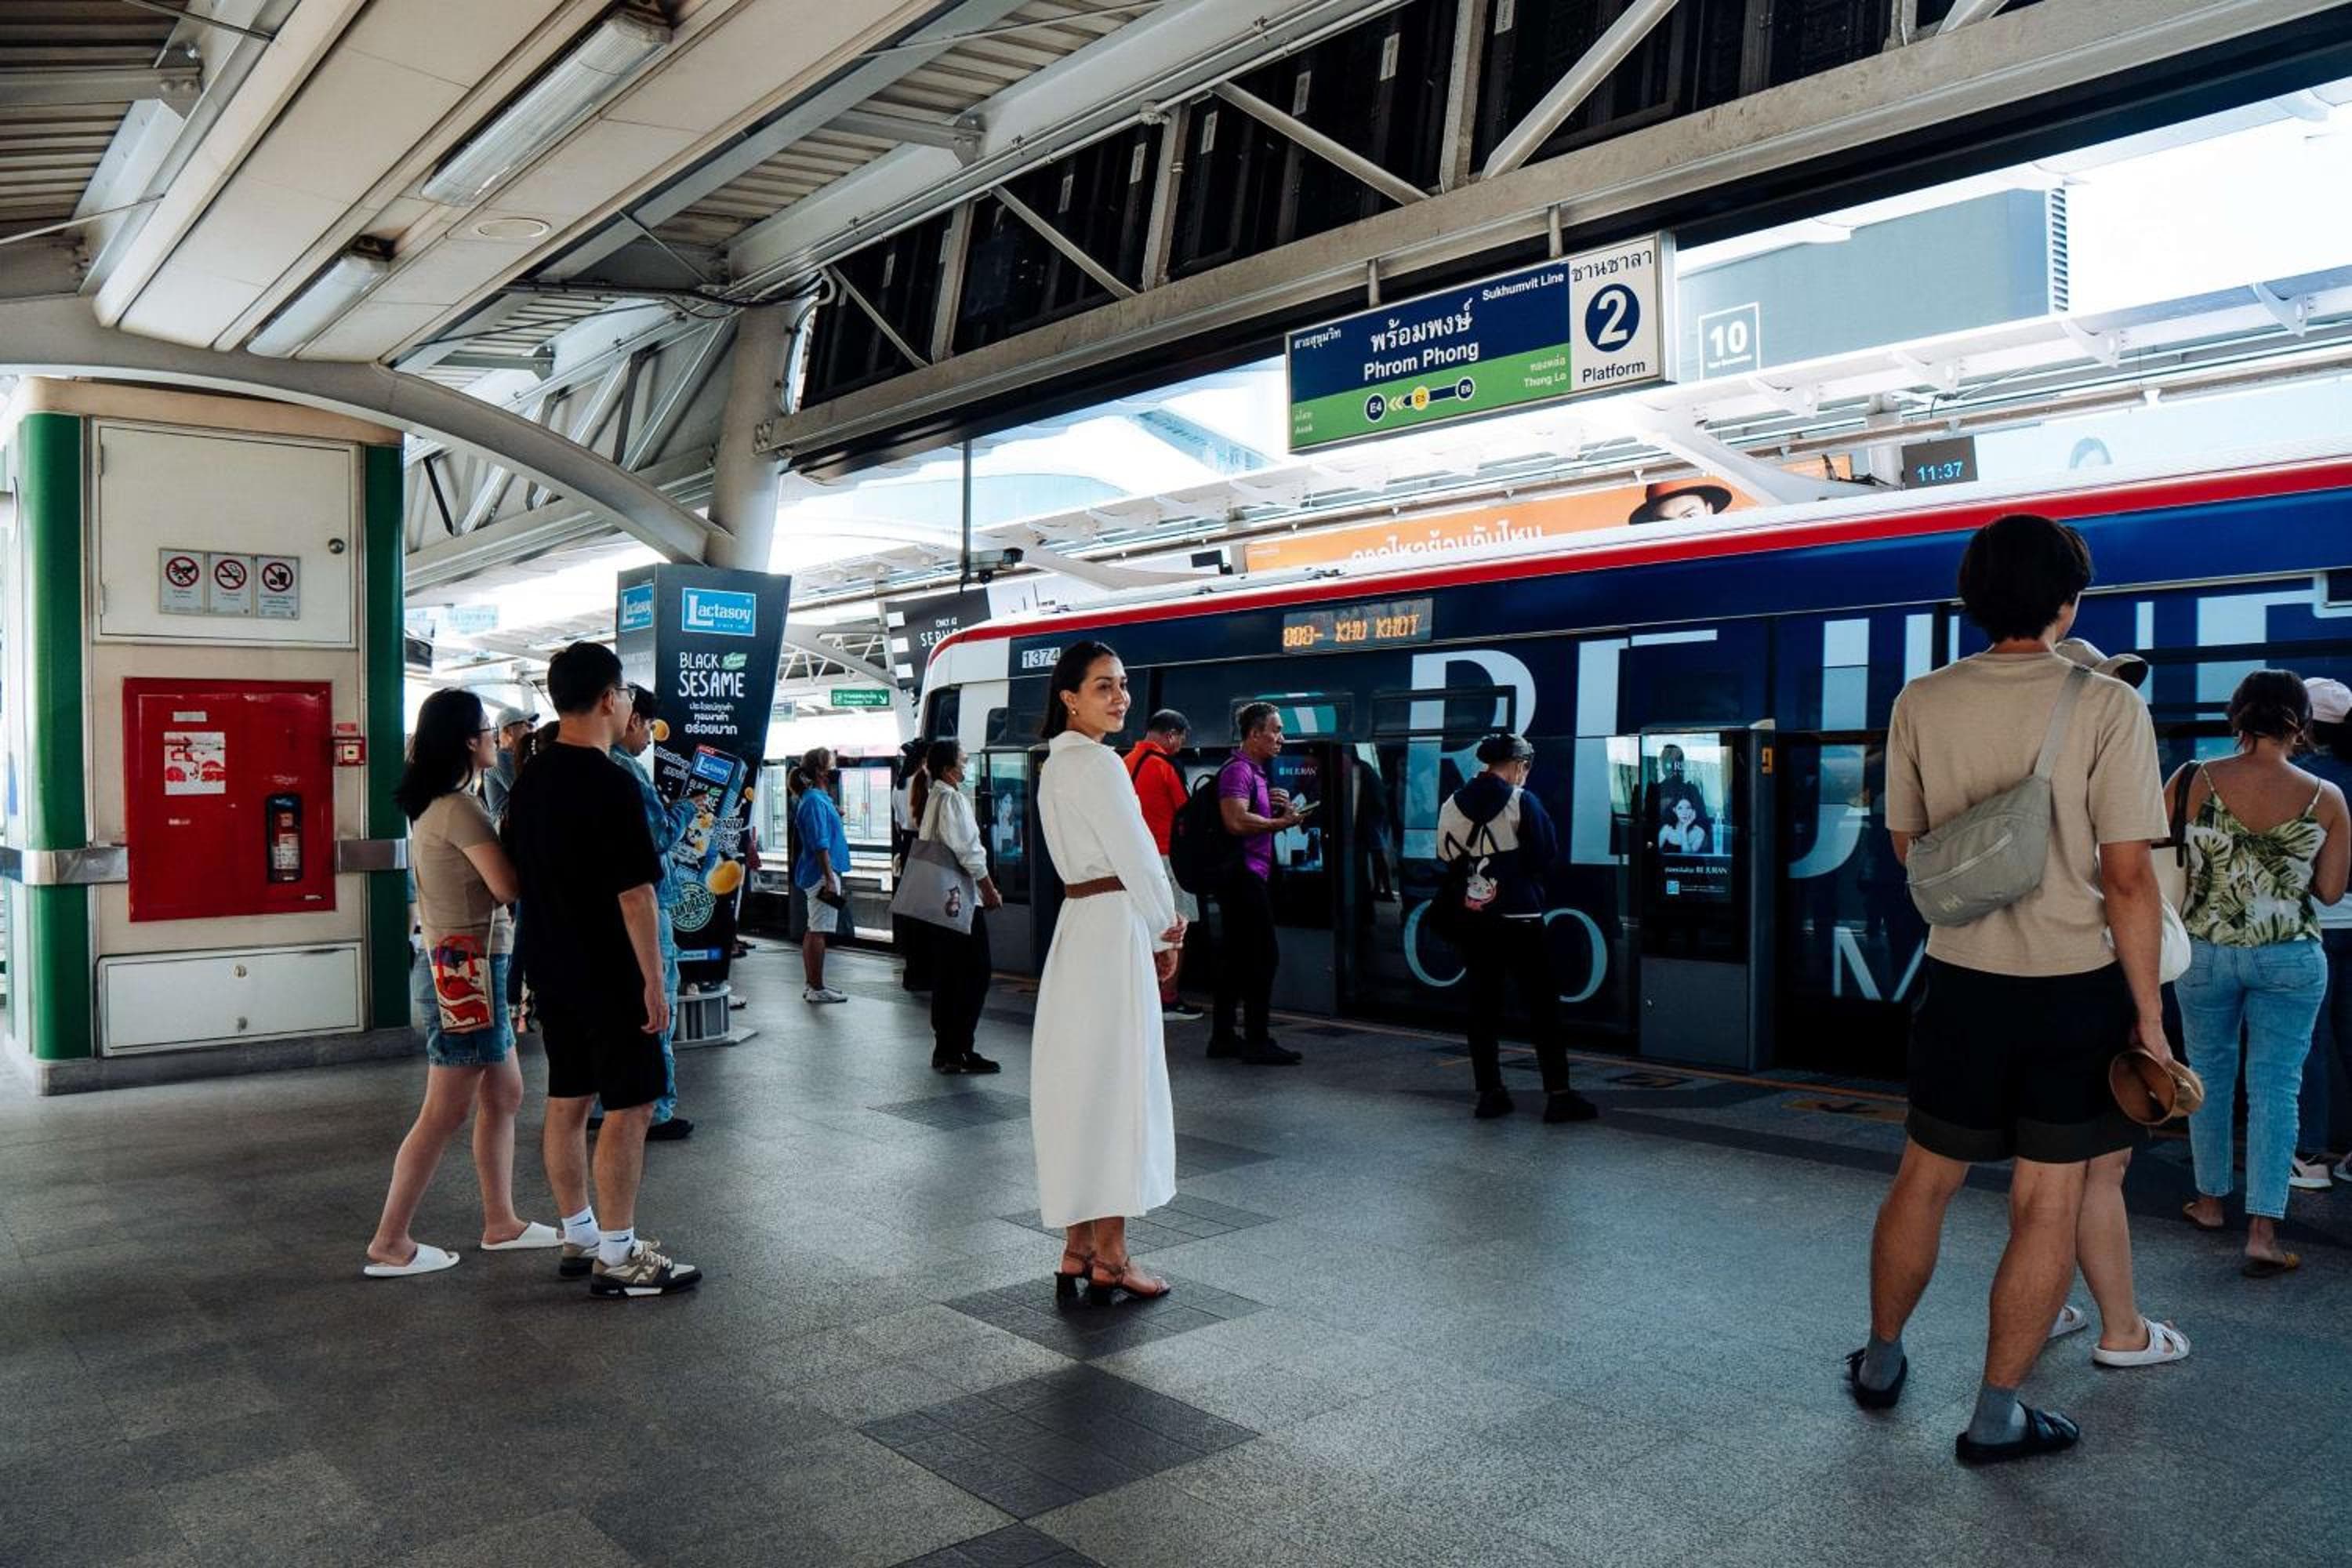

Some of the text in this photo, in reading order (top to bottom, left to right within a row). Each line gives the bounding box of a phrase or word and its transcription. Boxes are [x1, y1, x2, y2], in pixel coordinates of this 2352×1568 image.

[1572, 249, 1653, 282] ชานชาลา
[1483, 273, 1564, 300] Sukhumvit Line
[1370, 298, 1473, 353] พร้อมพงษ์
[1597, 289, 1628, 346] 2
[1710, 321, 1748, 357] 10
[1363, 342, 1479, 381] Phrom Phong
[1582, 361, 1646, 383] Platform
[1370, 401, 1382, 413] E4
[1918, 461, 1963, 481] 11:37
[688, 594, 752, 626] Lactasoy
[1336, 619, 1367, 642] KHU
[1376, 614, 1420, 639] KHOT
[679, 652, 720, 670] BLACK
[1024, 648, 1059, 667] 1374
[677, 671, 746, 698] SESAME
[684, 720, 738, 735] อร่อยมาก
